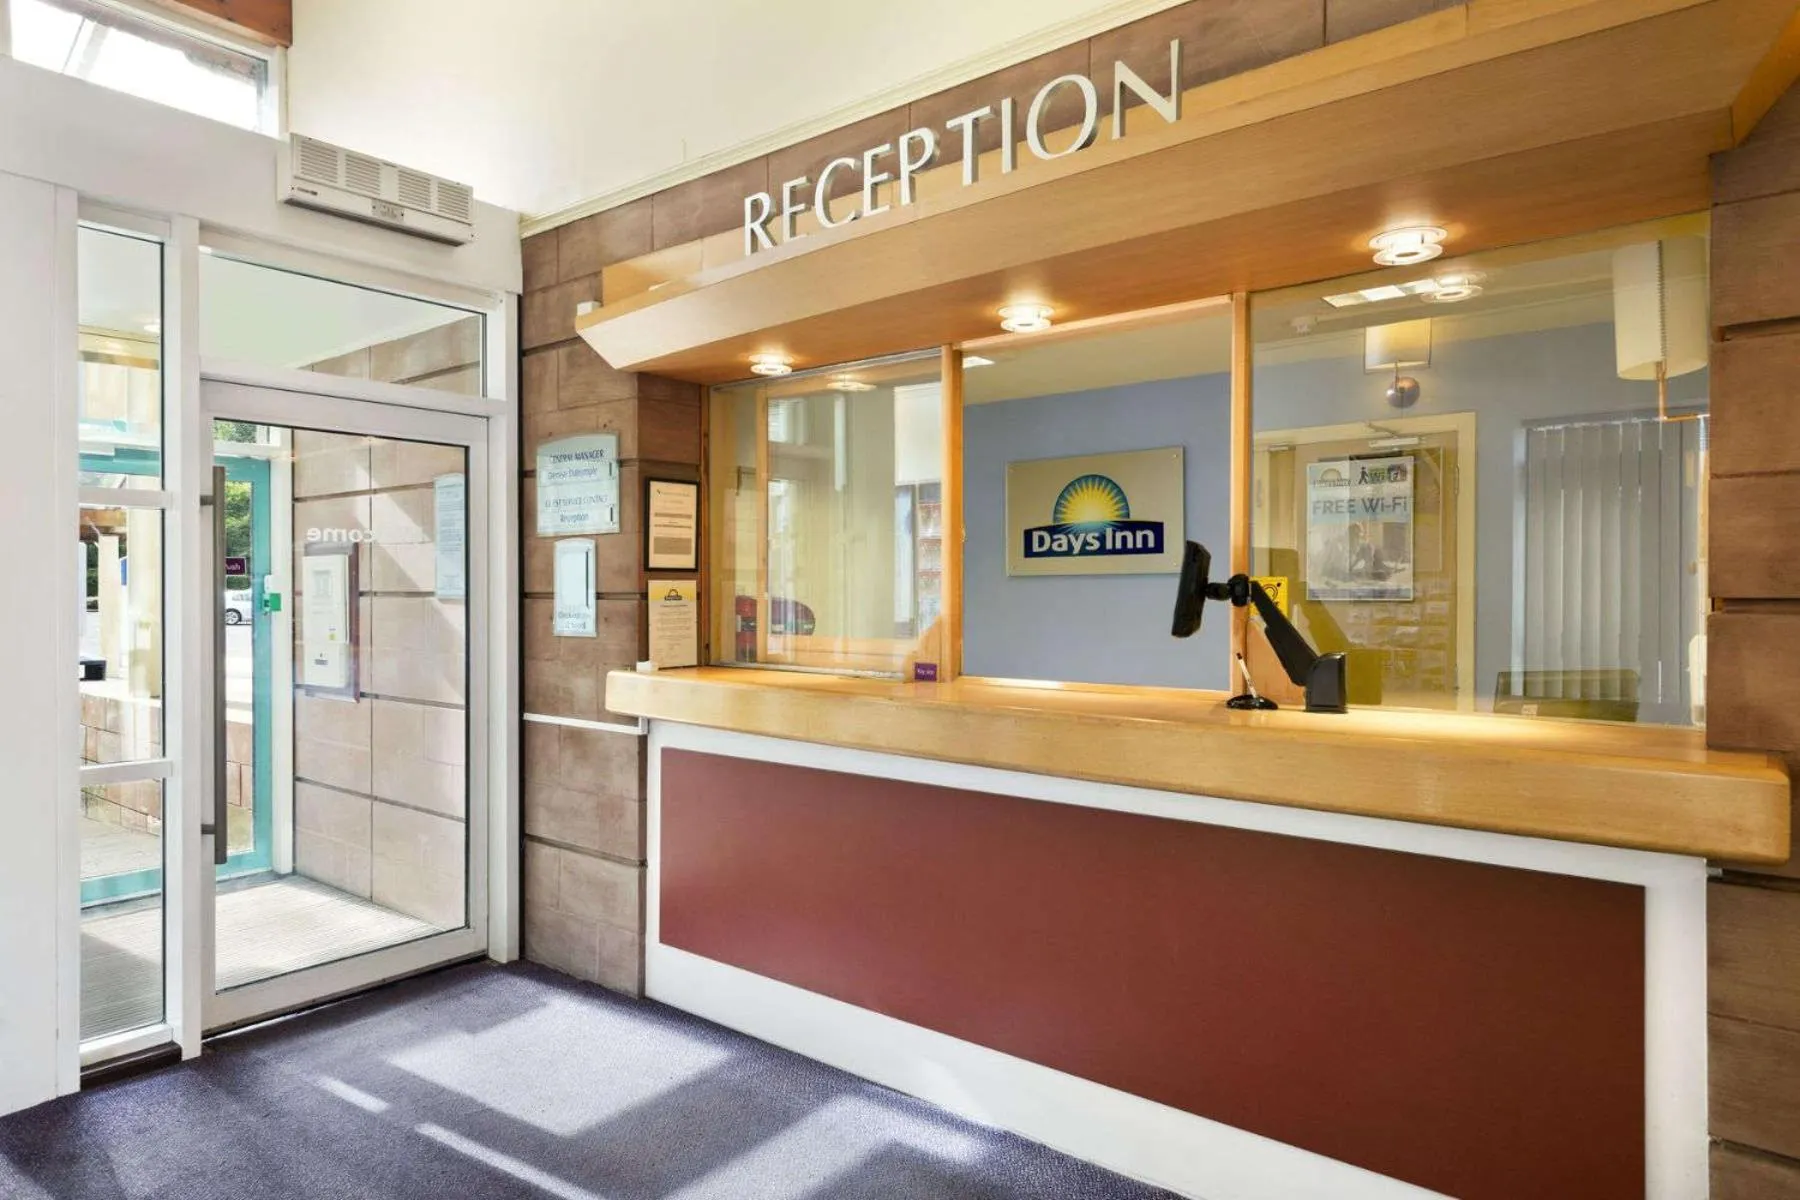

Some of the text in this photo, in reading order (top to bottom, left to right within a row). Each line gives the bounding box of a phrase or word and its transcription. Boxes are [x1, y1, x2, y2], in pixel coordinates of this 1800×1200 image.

[744, 39, 1182, 256] RECEPTION
[1312, 499, 1356, 515] FREE
[1032, 527, 1156, 556] Days Inn
